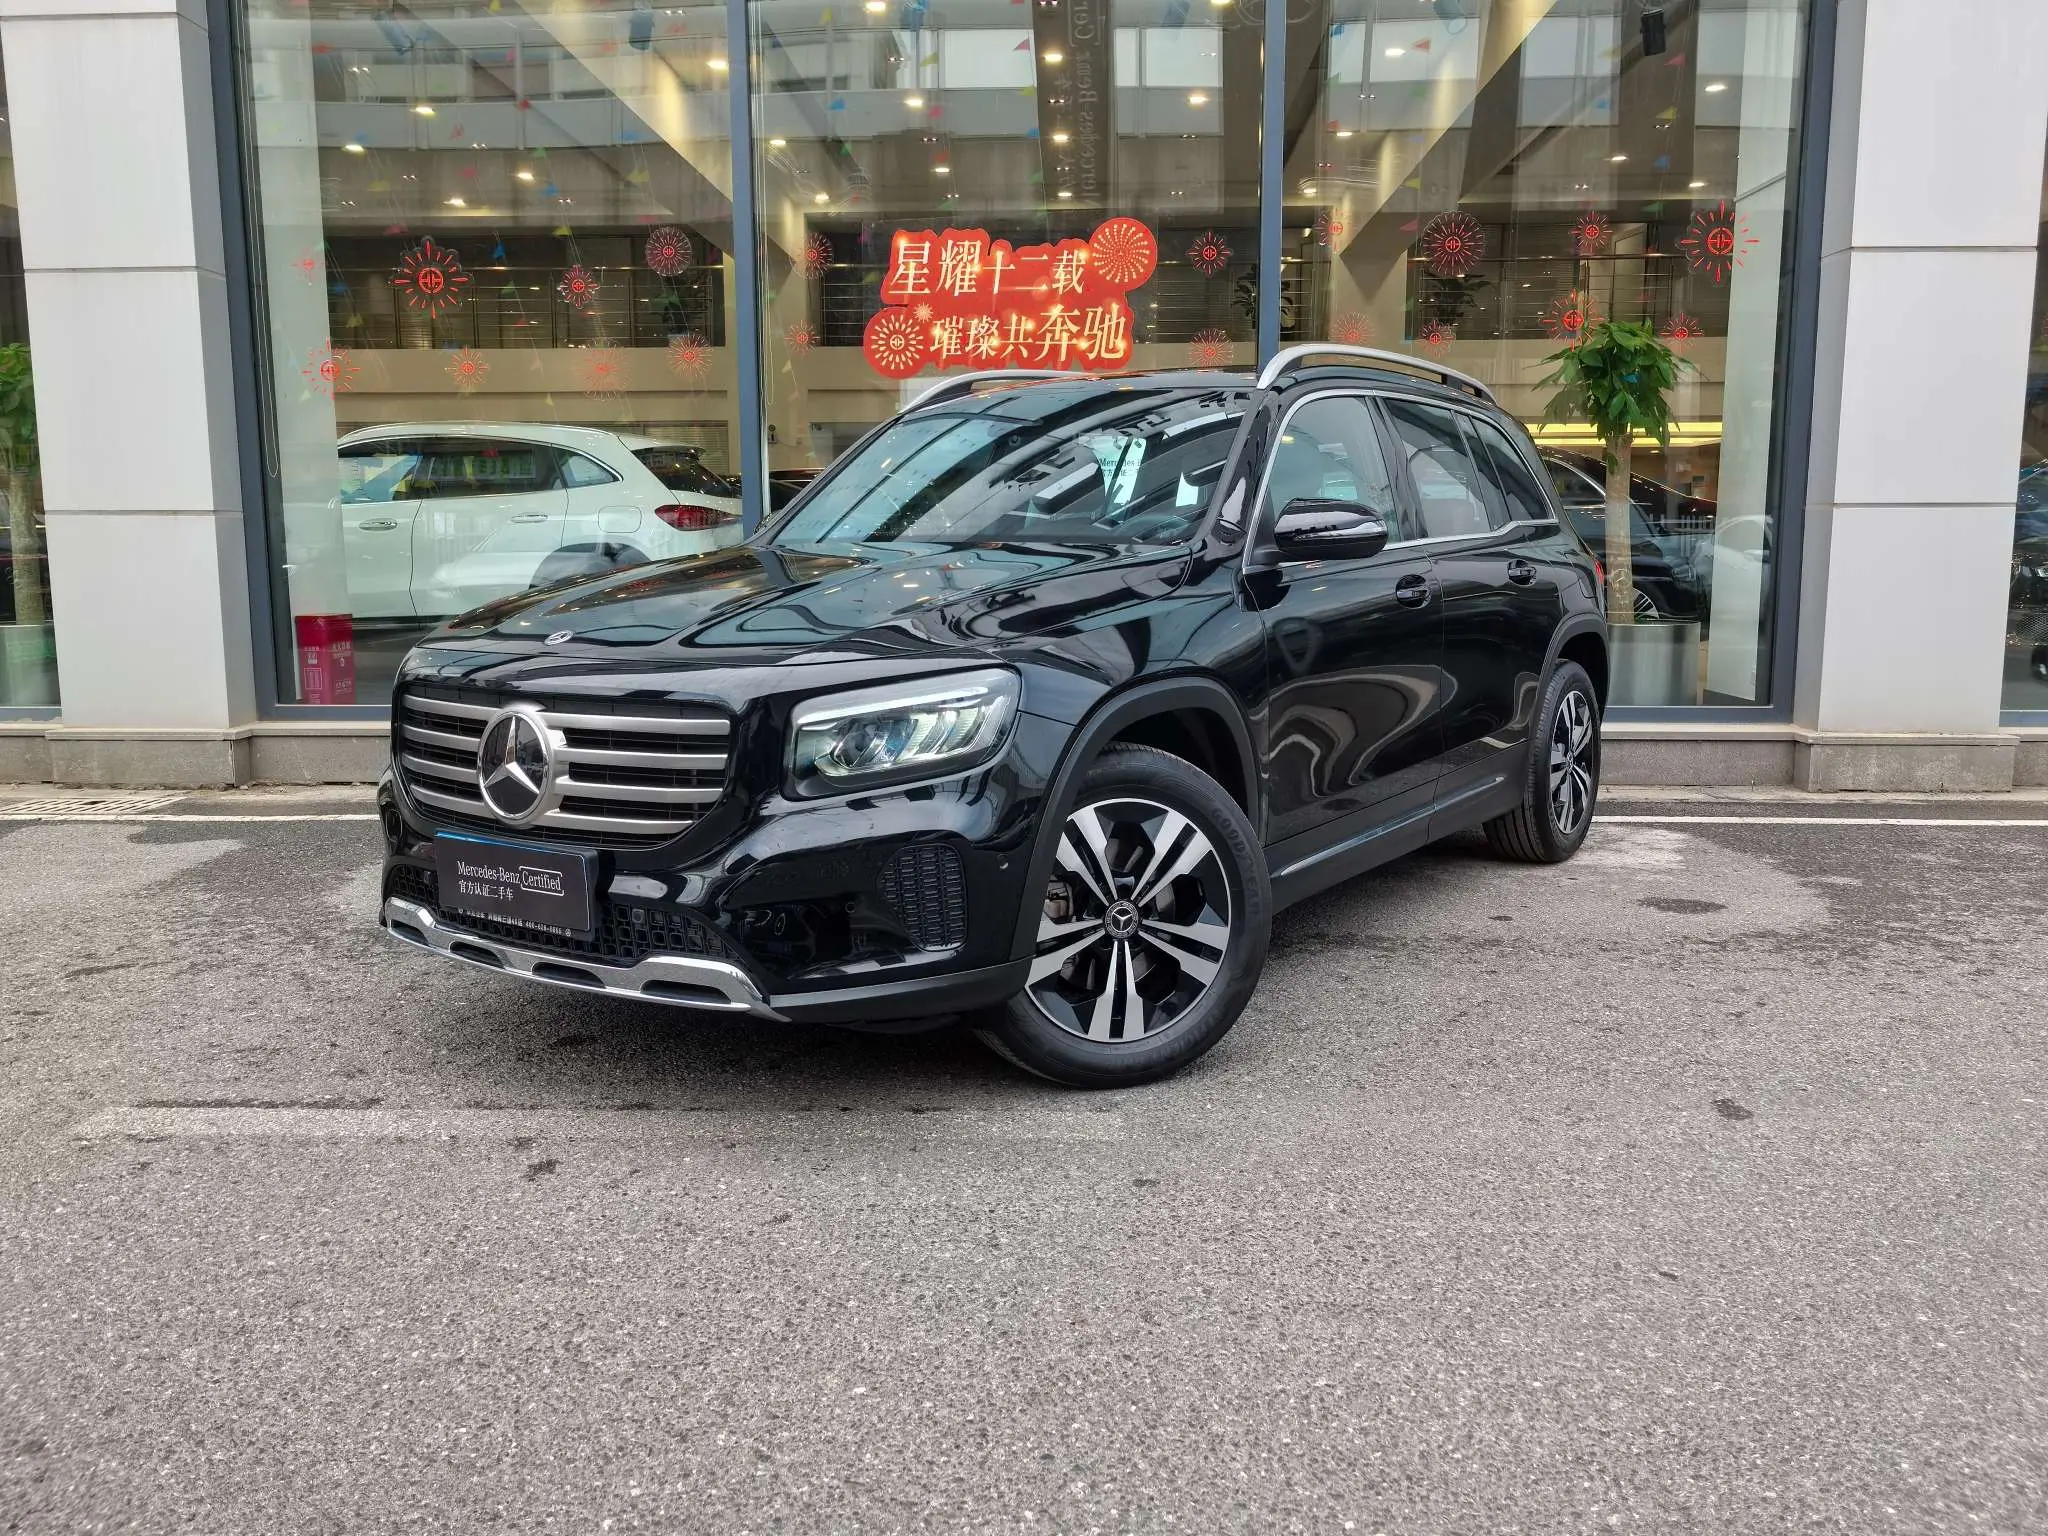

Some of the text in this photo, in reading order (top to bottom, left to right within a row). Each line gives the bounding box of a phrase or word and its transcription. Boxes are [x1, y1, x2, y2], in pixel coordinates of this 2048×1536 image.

[888, 239, 1088, 296] 星耀十二载
[930, 303, 1126, 362] 璀璨共奔驰
[457, 861, 561, 890] Mercedes-Benz Certified
[458, 879, 514, 900] 官方认证二手车
